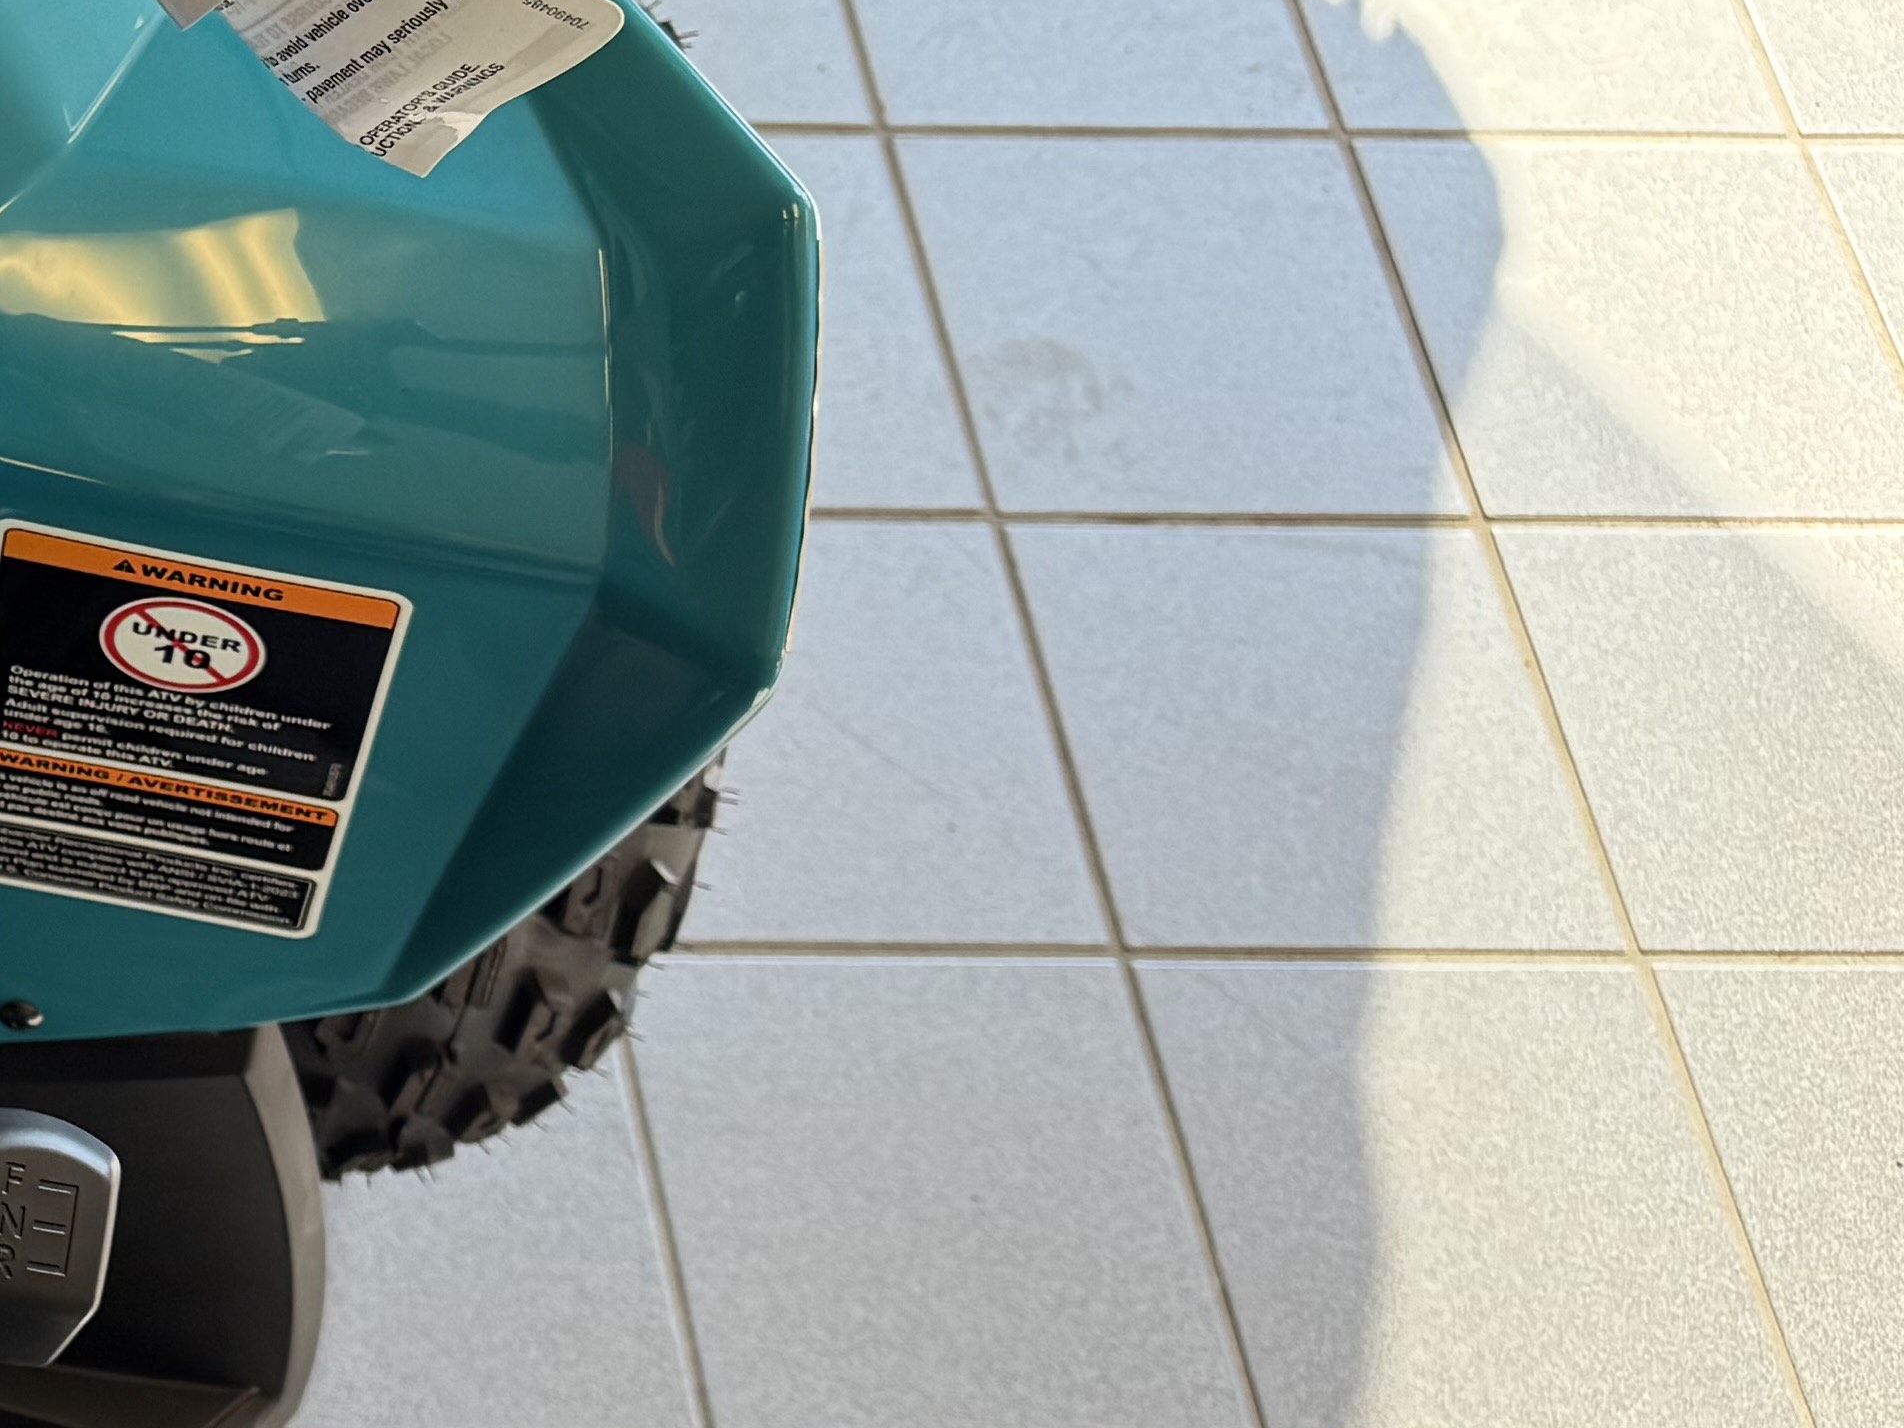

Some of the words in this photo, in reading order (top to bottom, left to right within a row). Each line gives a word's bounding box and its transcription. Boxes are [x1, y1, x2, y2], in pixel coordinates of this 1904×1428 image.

[274, 34, 310, 63] avoid
[302, 8, 351, 43] vehicle
[304, 57, 366, 105] pavement
[358, 39, 393, 65] may
[140, 562, 284, 602] WARNING
[131, 620, 242, 654] UNDER
[153, 643, 212, 672] 10
[2, 707, 51, 724] under
[51, 717, 84, 730] age
[6, 683, 75, 706] SEVERE
[77, 696, 141, 717] INJURY
[141, 708, 170, 722] OR
[172, 713, 234, 734] DEATH.
[7, 673, 35, 688] the
[36, 681, 68, 695] age
[69, 687, 90, 697] of
[112, 693, 194, 716] increases
[195, 707, 225, 721] the
[225, 714, 259, 728] risk
[260, 721, 282, 732] of
[9, 663, 90, 688] Operation
[91, 680, 112, 691] of
[112, 682, 145, 697] this
[146, 688, 183, 703] ATV
[183, 694, 207, 709] by
[208, 700, 278, 721] children
[279, 713, 332, 731] under
[1, 719, 59, 739] NEVER
[60, 731, 114, 749] permit
[115, 741, 183, 761] children
[184, 753, 235, 770] under
[235, 762, 268, 776] age
[3, 696, 49, 714] Adult
[49, 706, 146, 731] supervision
[147, 723, 219, 744] required
[219, 734, 245, 748] for
[246, 741, 317, 762] children
[21, 732, 40, 745] to
[40, 737, 103, 756] operate
[104, 748, 137, 762] this
[137, 754, 173, 768] ATV.
[126, 775, 328, 821] AVERTISSEMENT
[0, 1160, 27, 1196] F
